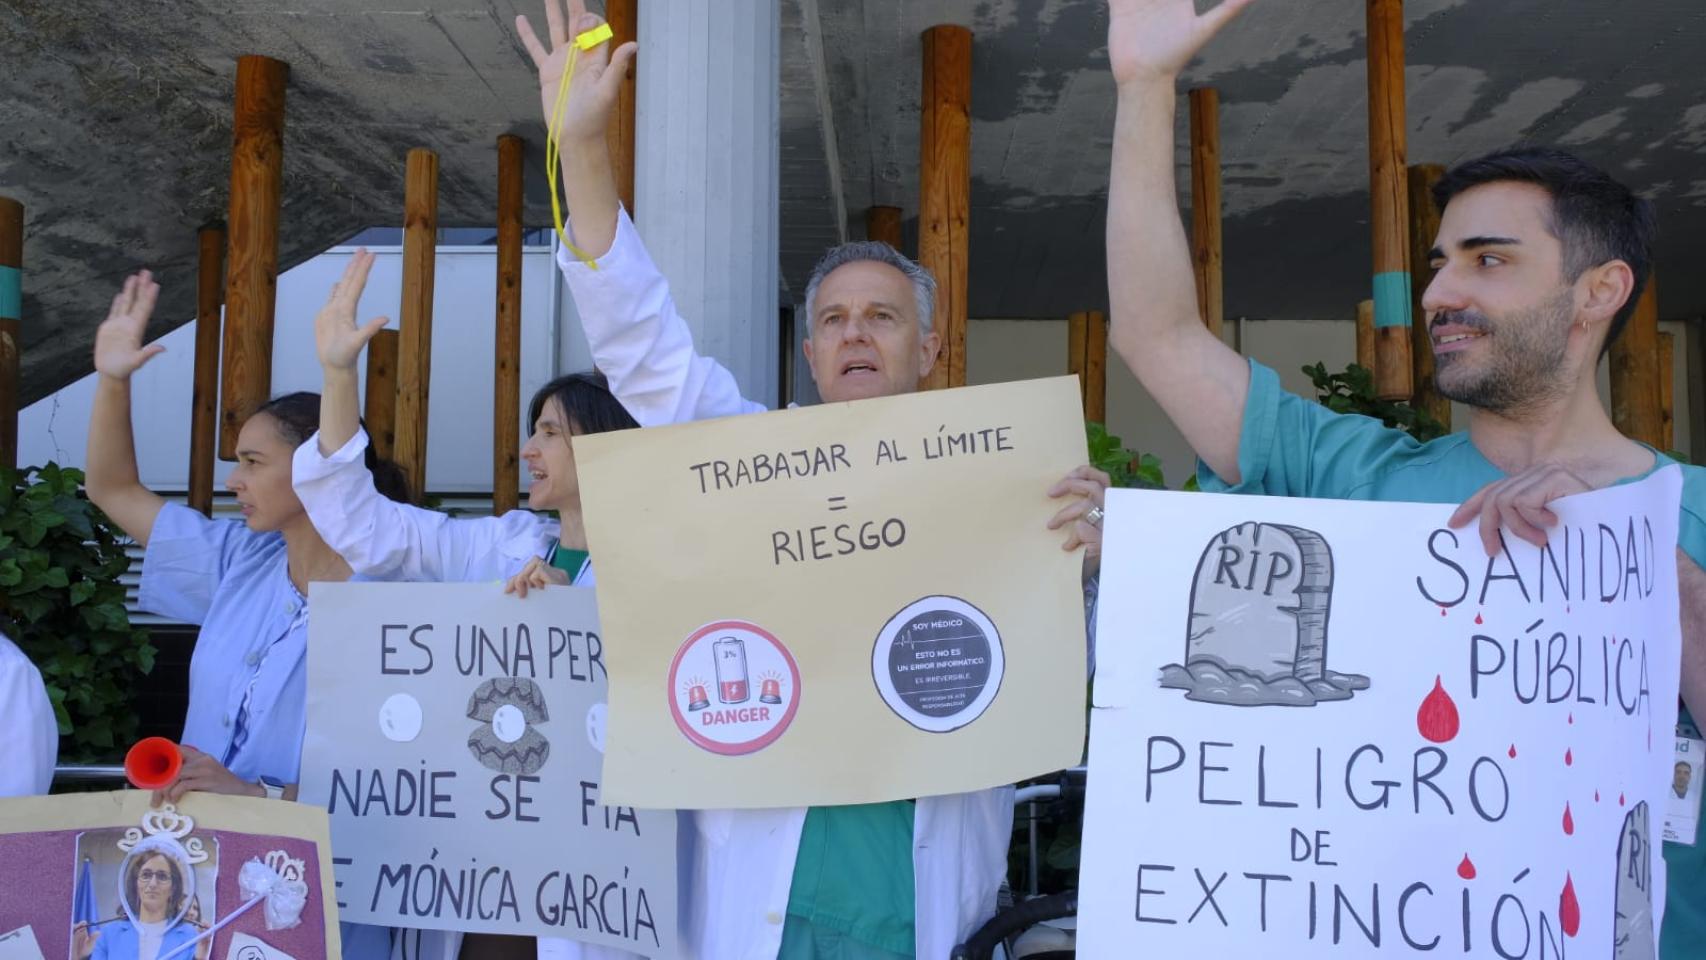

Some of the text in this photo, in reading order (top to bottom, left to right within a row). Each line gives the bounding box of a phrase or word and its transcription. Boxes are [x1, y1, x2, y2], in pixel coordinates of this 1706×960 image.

[690, 425, 1015, 494] TRABAJAR AL LÍMITE
[771, 517, 907, 566] RIESGO
[1416, 515, 1655, 608] SANIDAD
[1213, 545, 1294, 597] RIP
[380, 623, 434, 676] ES
[455, 623, 536, 678] UNA
[913, 623, 929, 631] SOY
[916, 648, 961, 659] ESTO NO ES
[898, 664, 909, 672] UN
[911, 662, 935, 671] ERROR
[1470, 618, 1651, 717] PÚBLICA
[702, 707, 770, 726] DANGER
[328, 760, 457, 819] NADIE
[485, 774, 541, 823] SE
[1144, 735, 1509, 823] PELIGRO
[1290, 827, 1339, 867] DE
[370, 847, 521, 923] MÓNICA
[535, 865, 660, 949] GARCÍA
[1134, 863, 1567, 960] EXTINCIÓN
